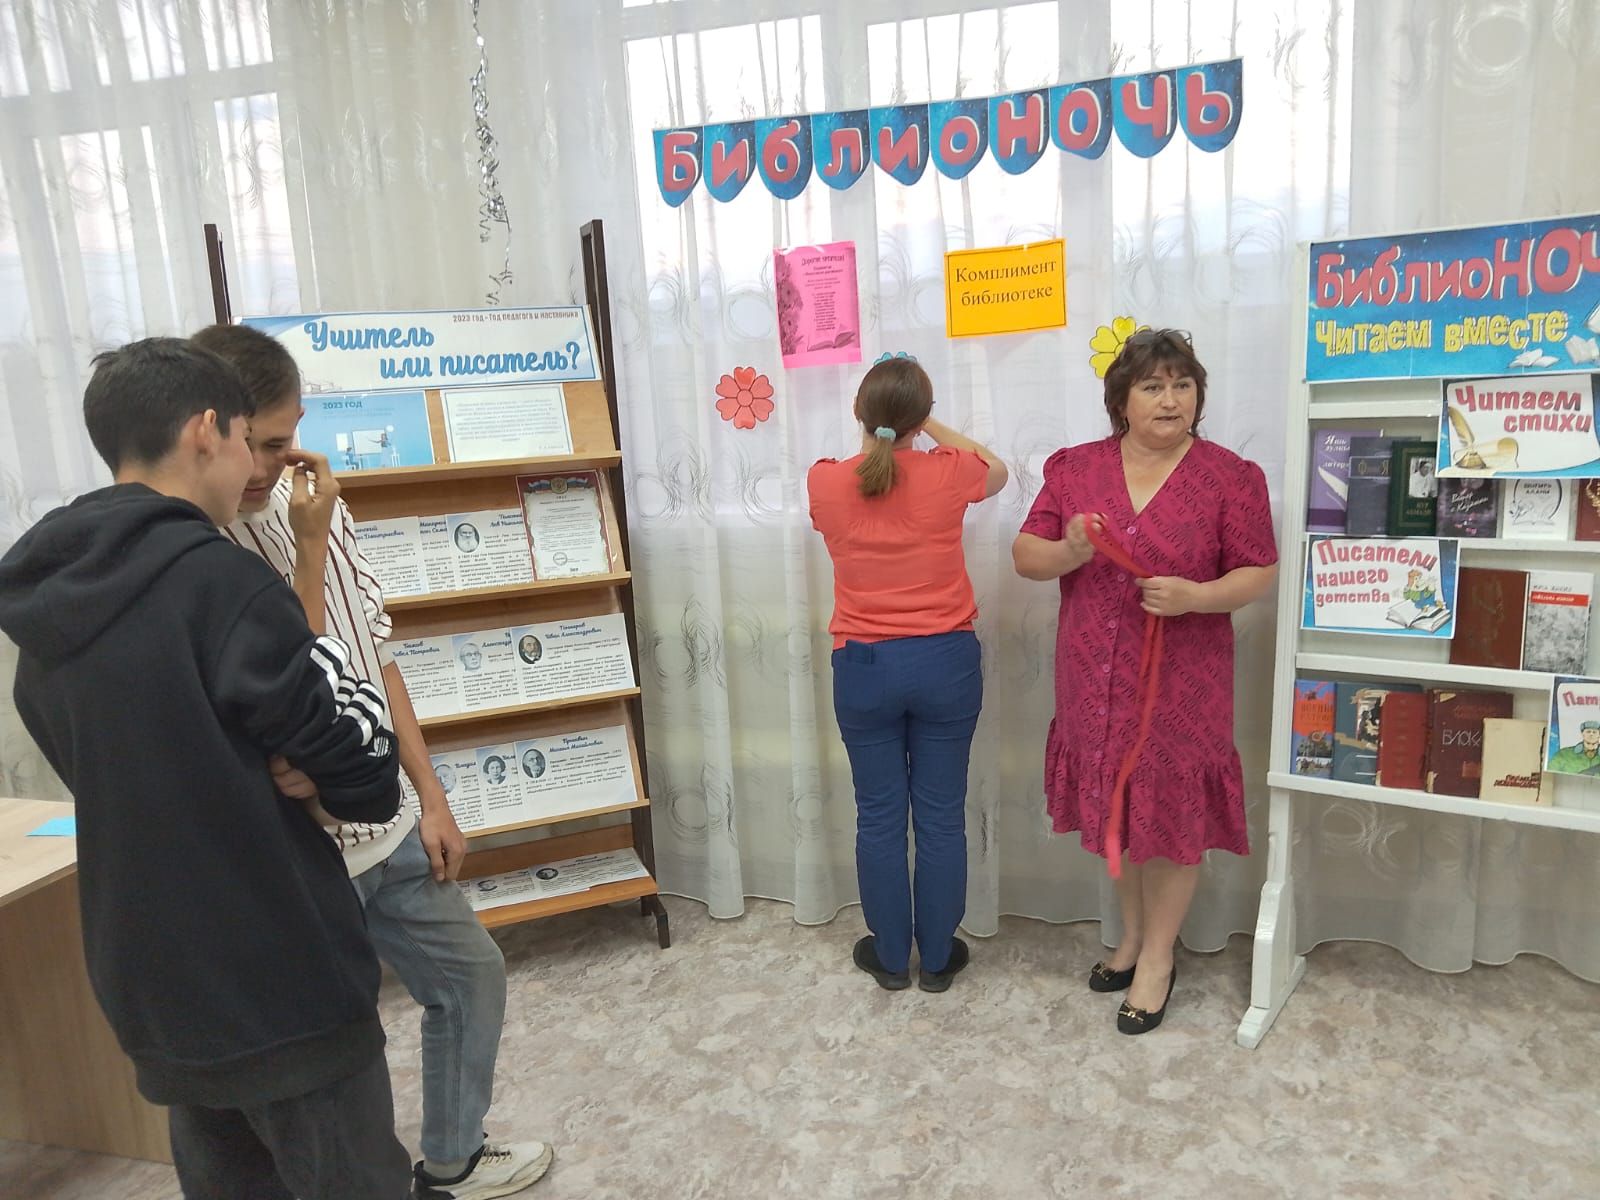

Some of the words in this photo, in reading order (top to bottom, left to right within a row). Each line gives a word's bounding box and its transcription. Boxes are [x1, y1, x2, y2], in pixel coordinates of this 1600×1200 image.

[956, 261, 1056, 282] Комплимент
[961, 286, 1053, 306] библиотеке
[453, 314, 470, 322] 2023
[304, 322, 435, 351] Учитель
[1315, 320, 1432, 357] Читаем
[1445, 310, 1568, 352] вместе
[380, 357, 433, 379] или
[439, 341, 580, 376] писатель?
[323, 401, 343, 409] 2023
[1455, 385, 1582, 412] Читаем
[1503, 413, 1593, 433] стихи
[1317, 539, 1437, 571] Писатели
[1316, 568, 1389, 587] нашего
[1316, 589, 1391, 607] детства
[1562, 690, 1600, 708] Пат
